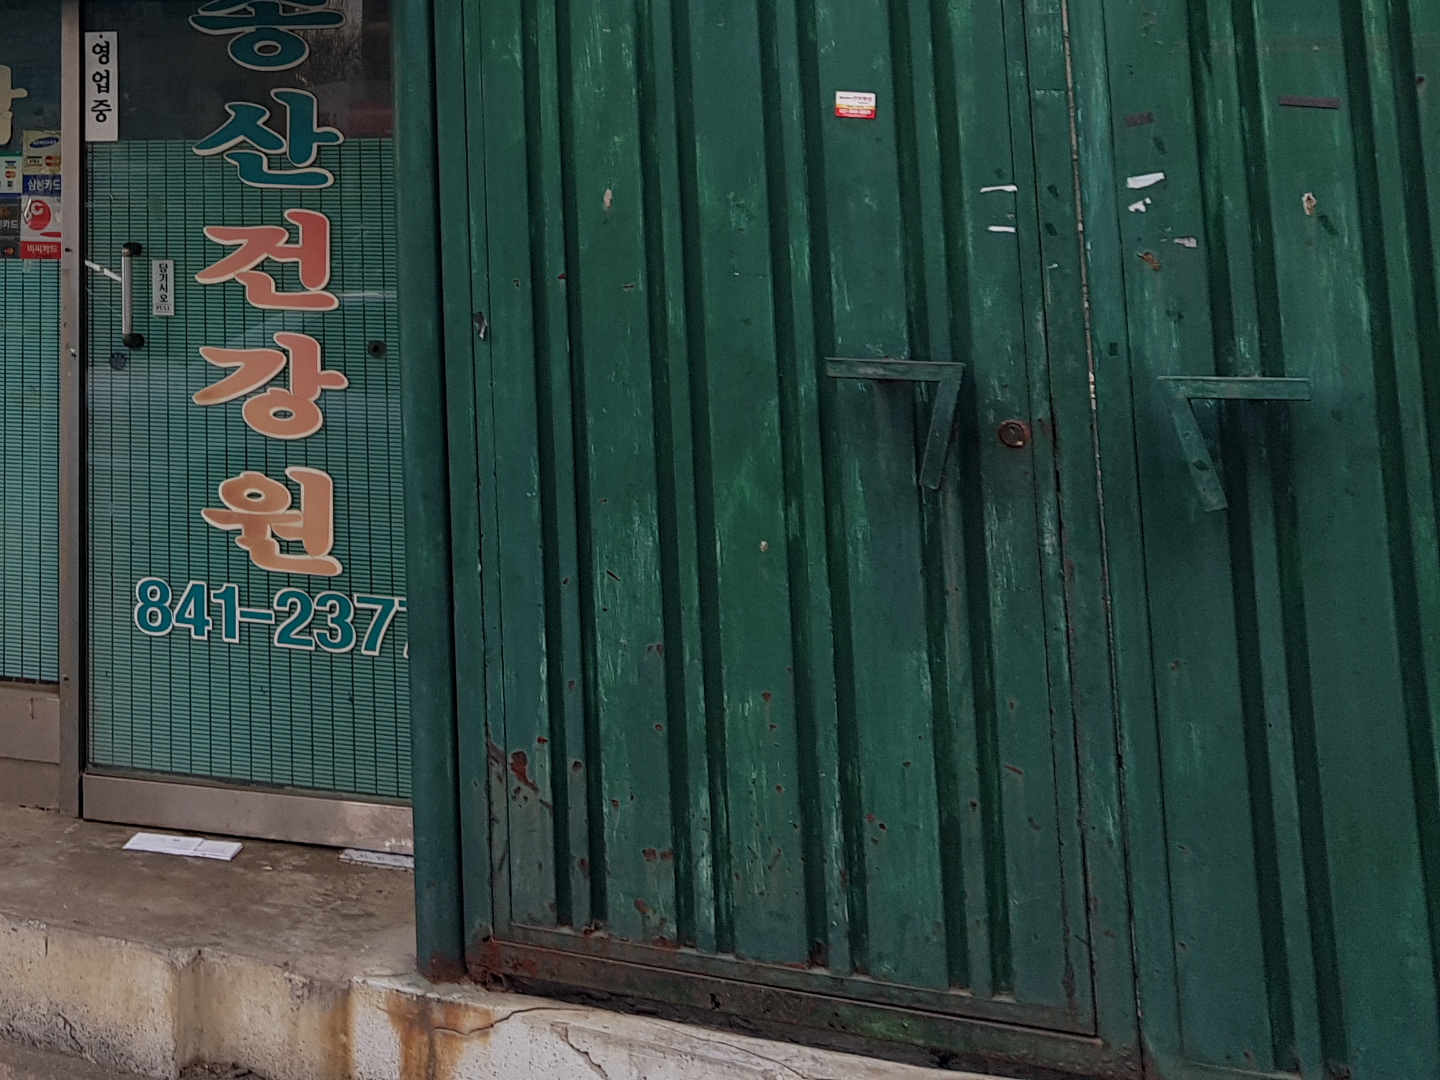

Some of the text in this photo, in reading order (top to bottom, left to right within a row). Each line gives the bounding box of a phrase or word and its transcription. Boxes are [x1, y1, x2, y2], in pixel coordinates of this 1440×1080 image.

[90, 39, 113, 124] 영업중
[158, 262, 169, 303] 당기시오
[134, 576, 409, 658] 841-237
